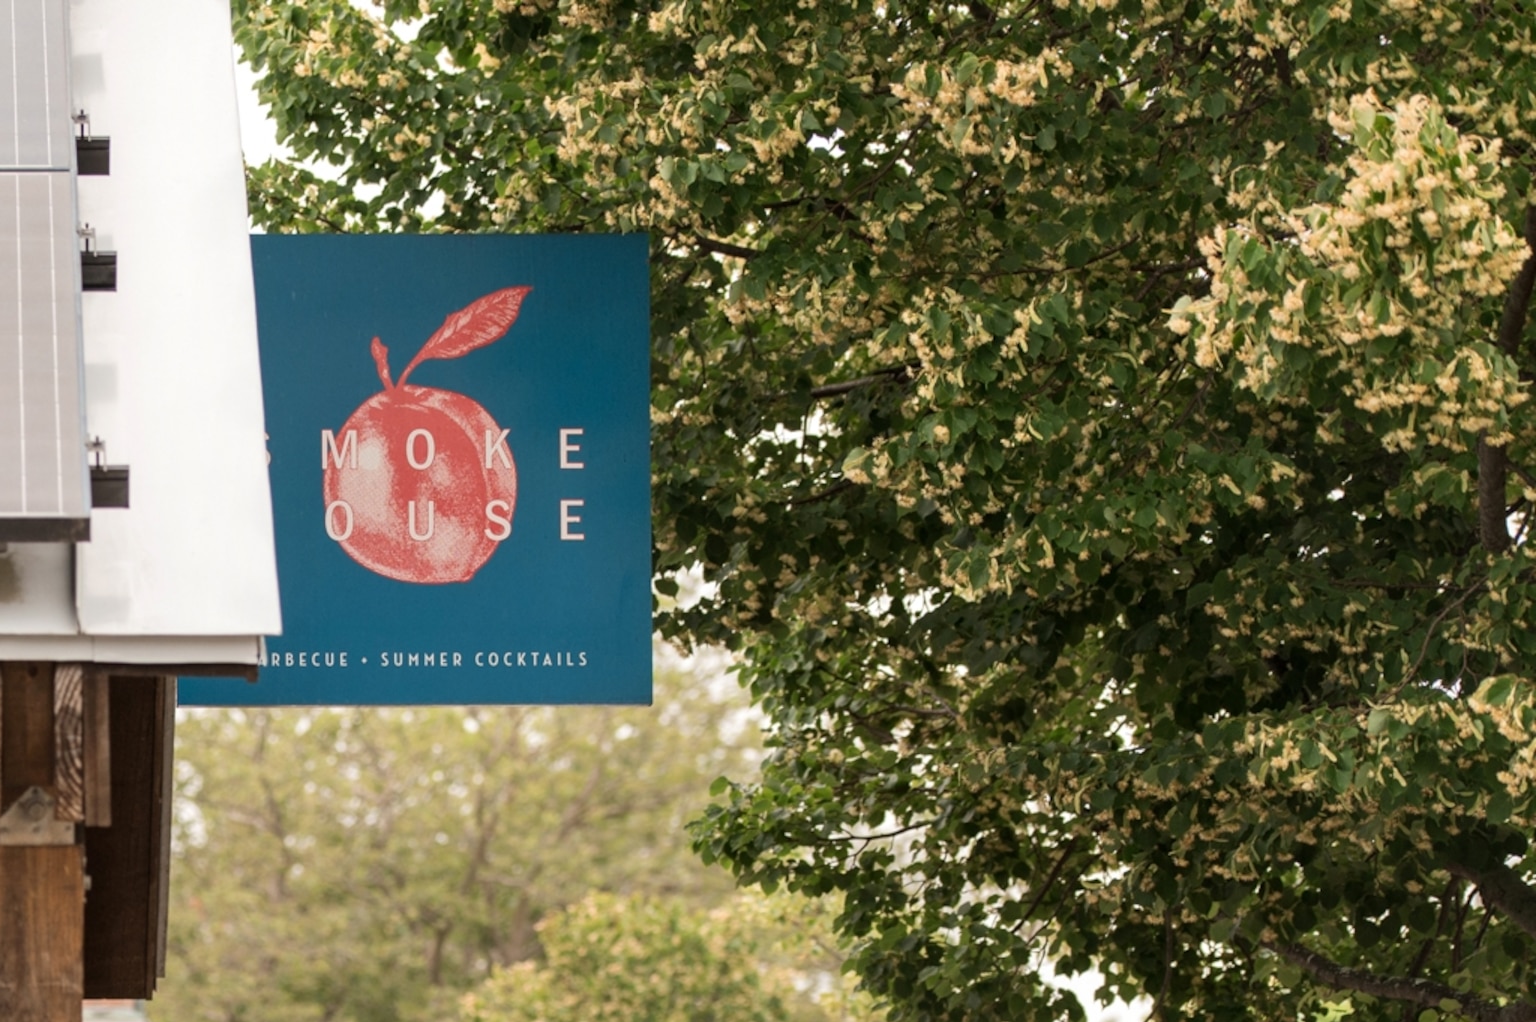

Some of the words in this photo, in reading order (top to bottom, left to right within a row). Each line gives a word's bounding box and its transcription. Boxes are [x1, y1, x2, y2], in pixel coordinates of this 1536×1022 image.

[264, 427, 584, 471] MOKE
[324, 499, 585, 542] OUSE
[257, 651, 348, 668] ARBECUE
[380, 651, 463, 667] SUMMER
[474, 651, 588, 667] COCKTAILS
